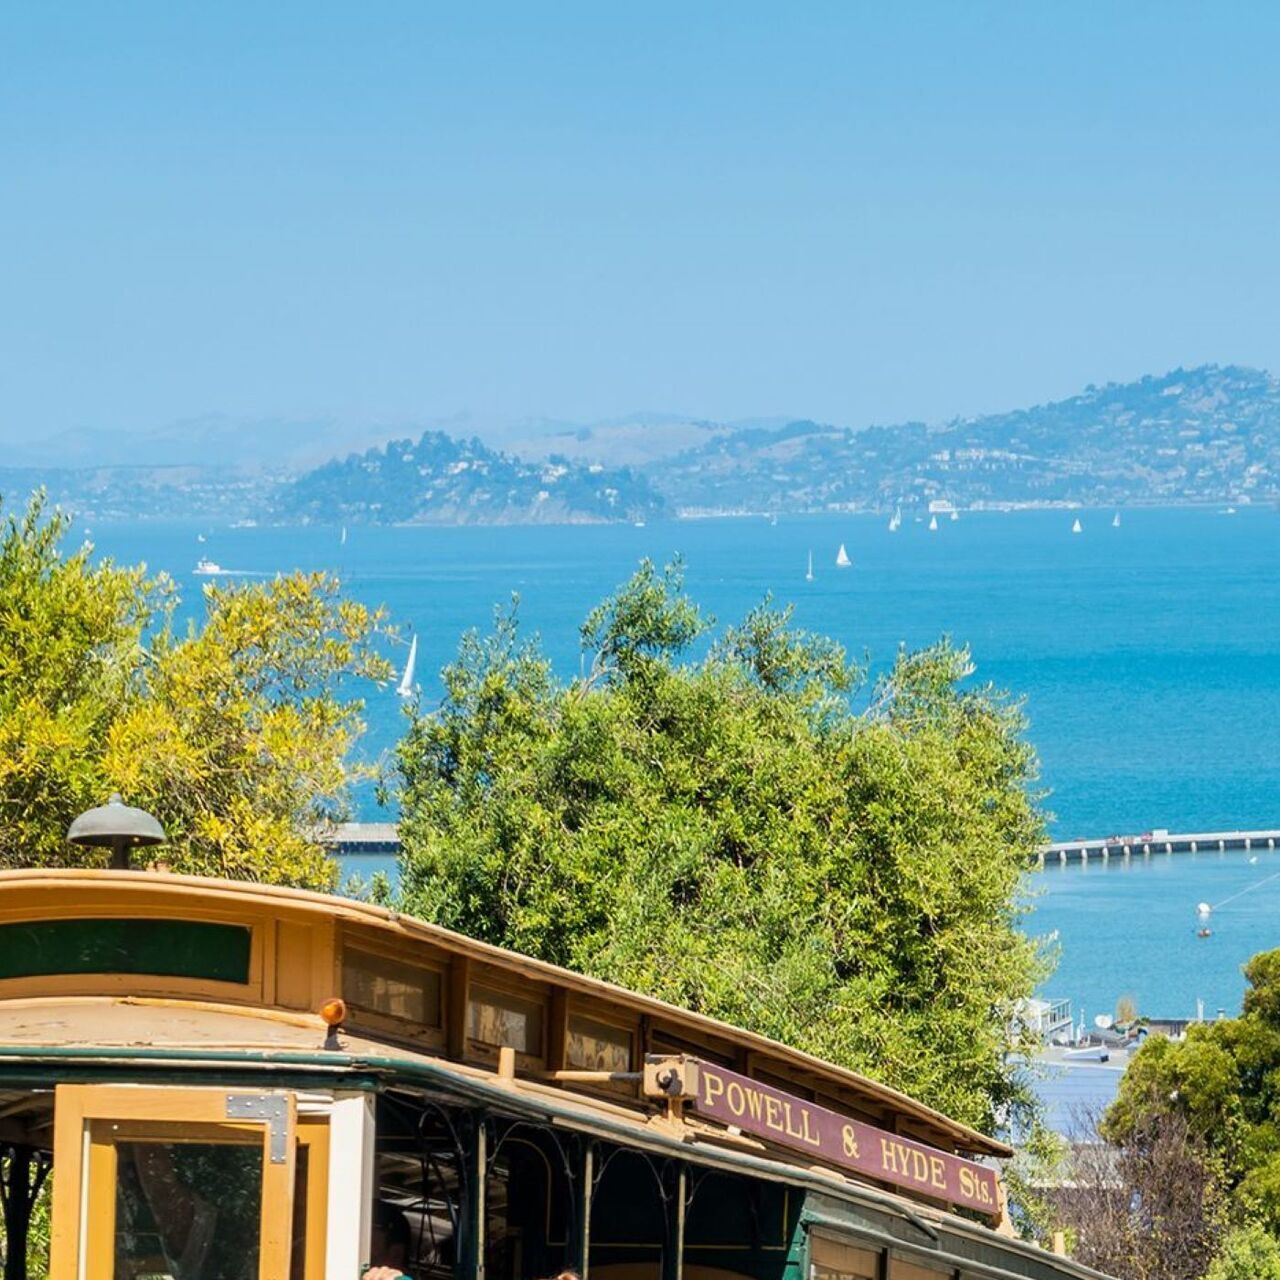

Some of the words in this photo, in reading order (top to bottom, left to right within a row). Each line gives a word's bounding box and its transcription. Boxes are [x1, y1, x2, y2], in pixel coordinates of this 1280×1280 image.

[702, 1071, 820, 1147] POWELL
[841, 1124, 861, 1159] &
[881, 1138, 948, 1190] HYDE
[958, 1166, 994, 1205] Sts.
